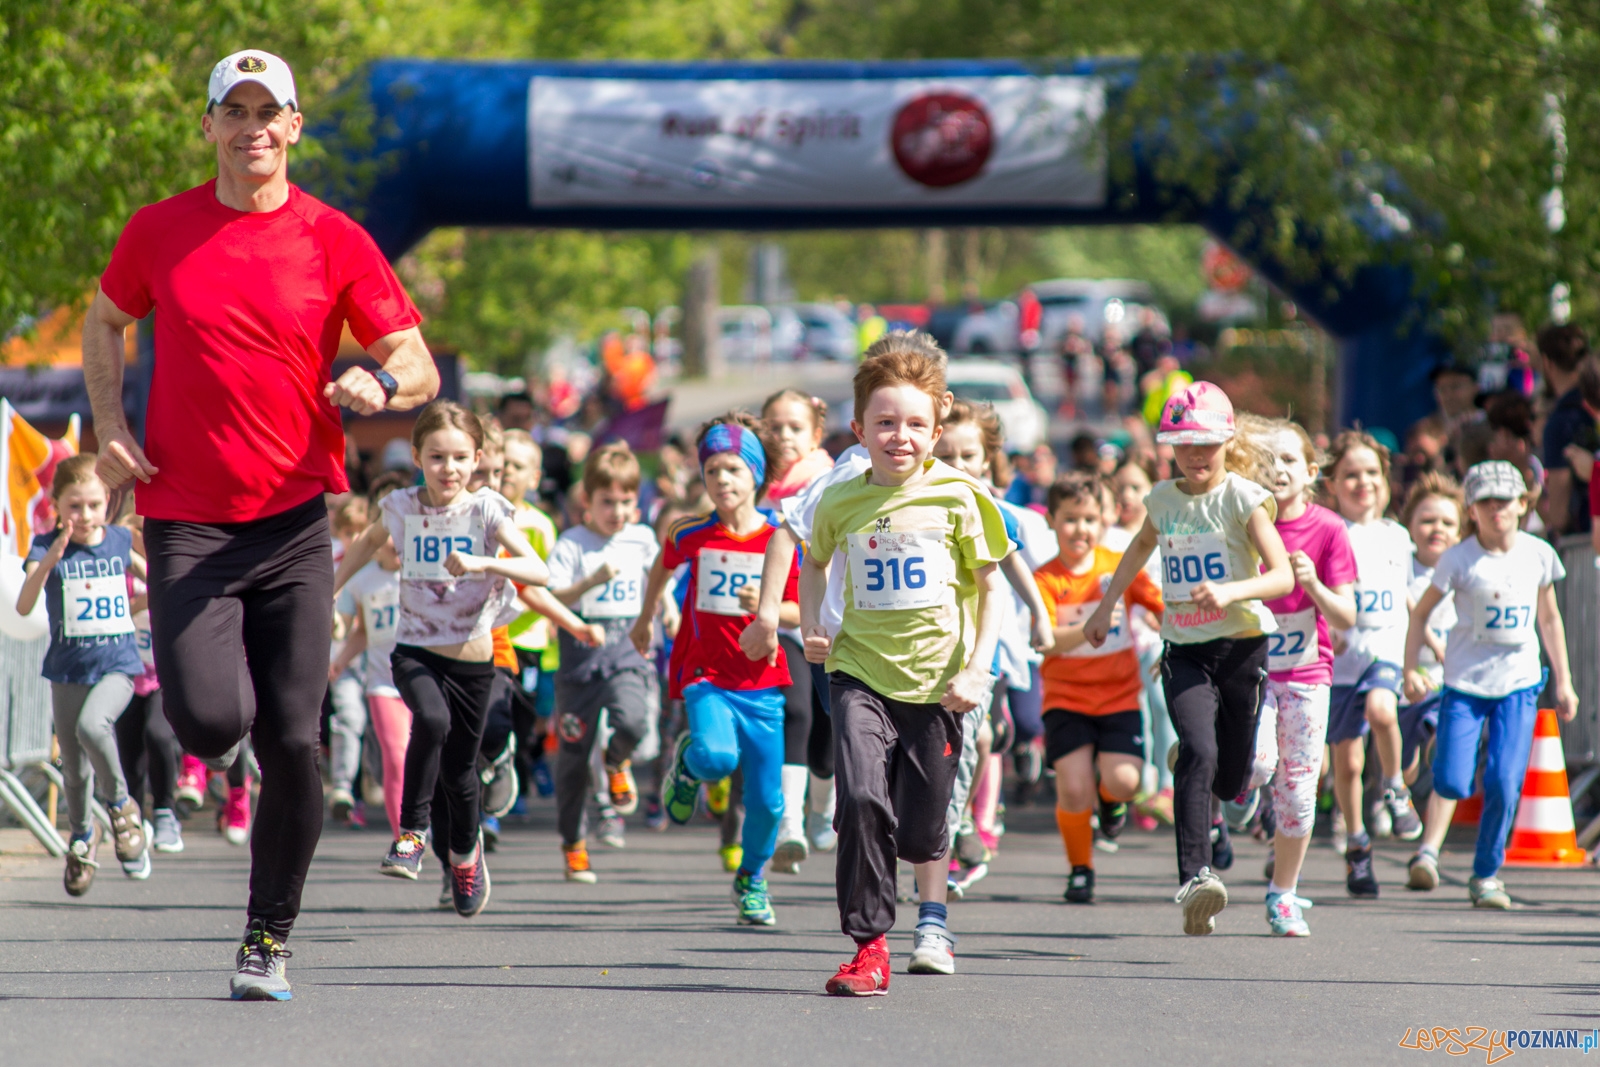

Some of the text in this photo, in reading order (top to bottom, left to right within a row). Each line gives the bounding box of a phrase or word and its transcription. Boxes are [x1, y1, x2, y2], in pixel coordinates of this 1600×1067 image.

[413, 535, 473, 562] 1813
[63, 556, 124, 580] HERO
[864, 557, 926, 591] 316
[1163, 552, 1225, 584] 1806
[596, 581, 636, 602] 265
[76, 596, 124, 621] 288
[371, 605, 400, 629] 27
[1485, 606, 1530, 629] 257
[1267, 630, 1305, 656] 22
